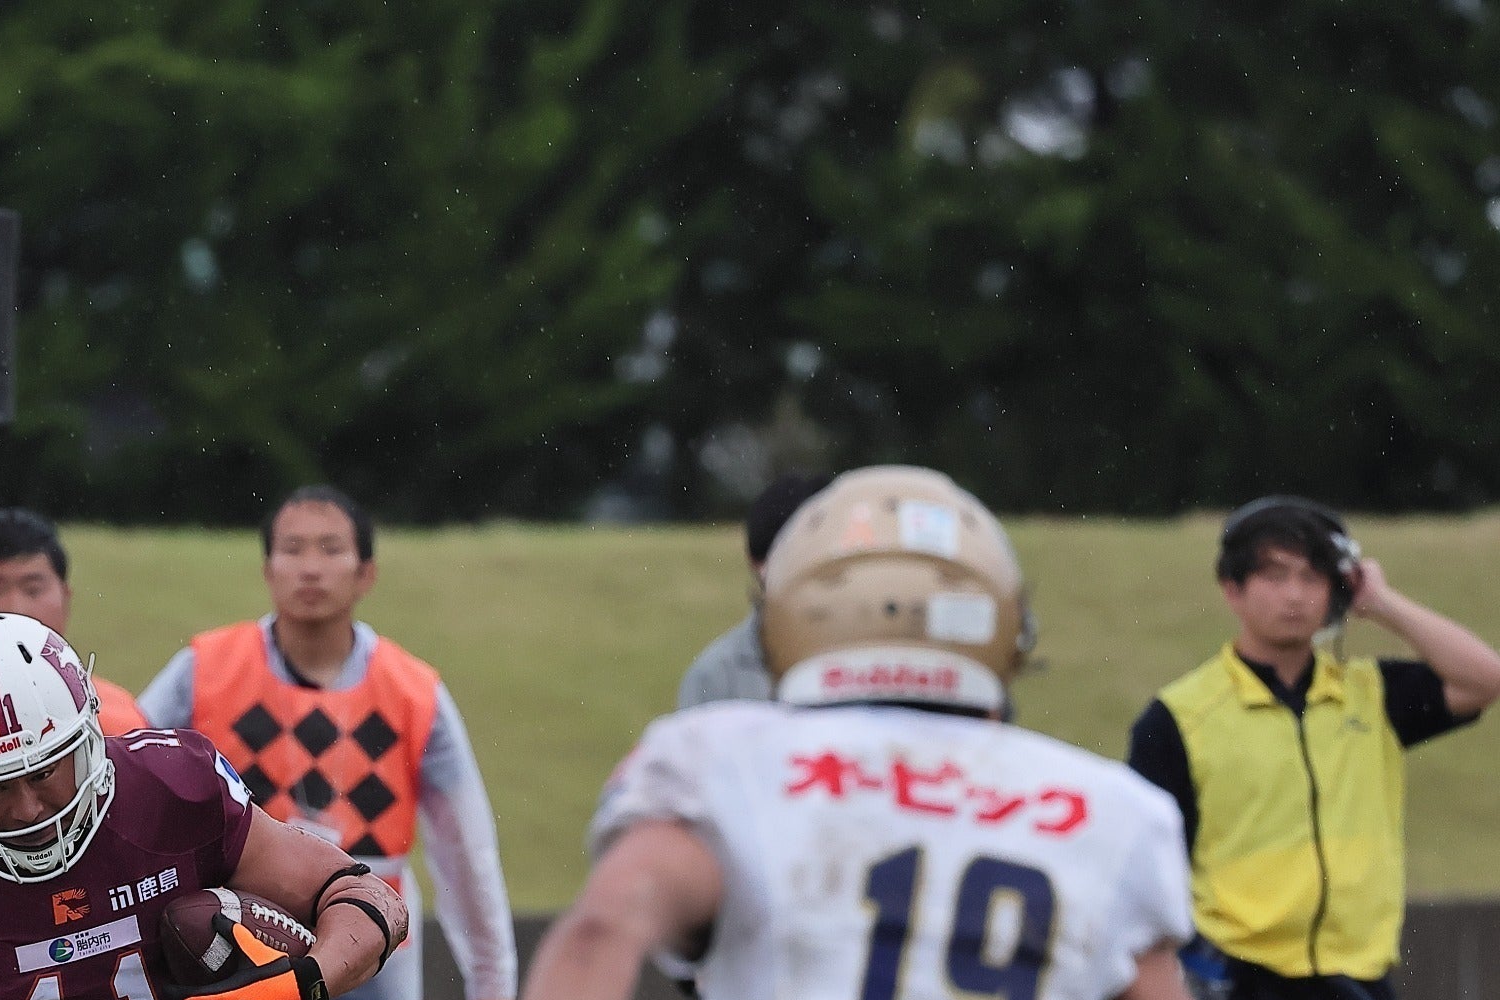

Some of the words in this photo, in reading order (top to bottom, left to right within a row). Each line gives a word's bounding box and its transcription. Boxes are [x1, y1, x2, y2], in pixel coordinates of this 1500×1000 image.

[786, 752, 1089, 835] オービック
[26, 849, 54, 861] Riddell
[75, 932, 112, 952] 胎内市
